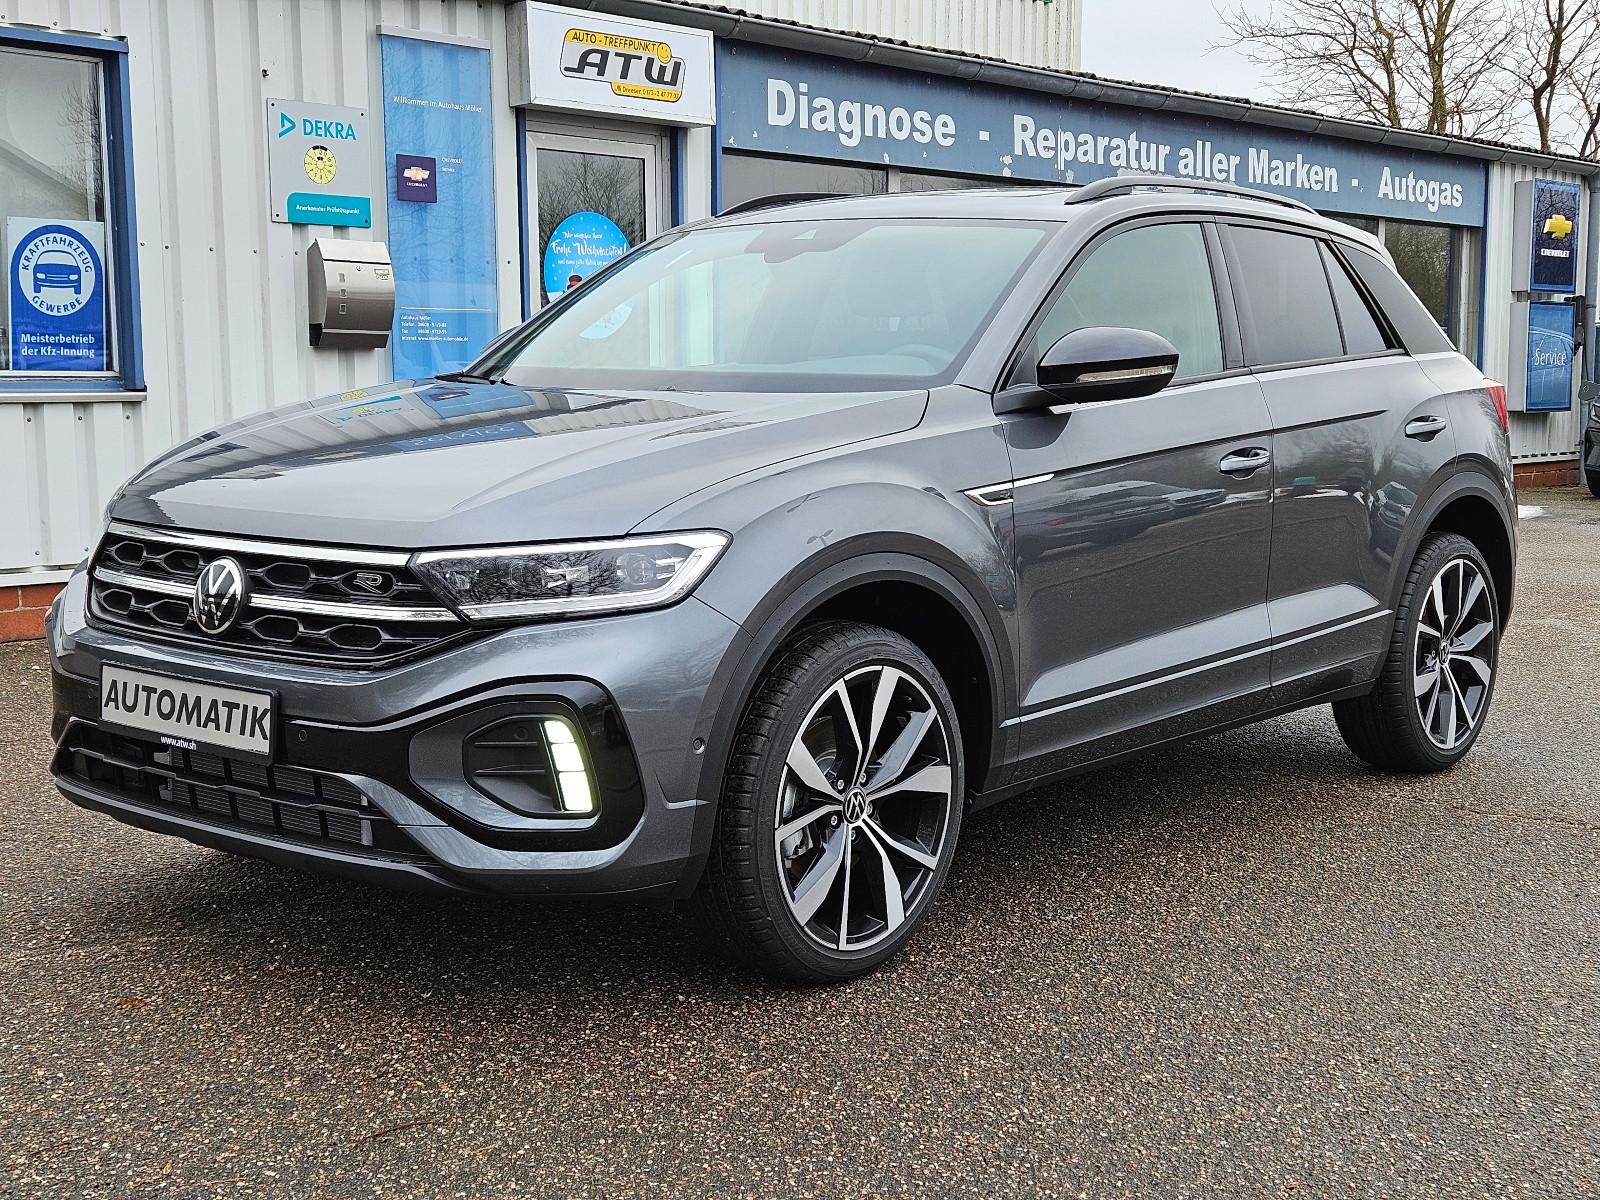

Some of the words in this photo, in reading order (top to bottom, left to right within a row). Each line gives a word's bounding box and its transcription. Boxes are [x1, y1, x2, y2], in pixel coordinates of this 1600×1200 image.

[572, 31, 597, 44] AUTO
[603, 36, 657, 53] TREFFPUNKT
[564, 48, 682, 86] ATW
[393, 95, 429, 106] Willkommen
[438, 101, 465, 111] Autohaus
[302, 118, 357, 140] DEKRA
[767, 78, 956, 147] Diagnose
[1013, 114, 1171, 172] Reparatur
[1178, 140, 1241, 182] aller
[1248, 147, 1339, 193] Marken
[1377, 166, 1463, 213] Autogas
[21, 236, 93, 273] KRAFTFAHRZEUG
[32, 295, 83, 314] GEWERBE
[21, 333, 95, 344] Meisterbetrieb
[21, 346, 38, 356] der
[41, 346, 95, 359] Kfz-Innung
[1534, 349, 1567, 367] Service
[103, 679, 271, 741] AUTOMATIK
[160, 735, 197, 751] www.atw.sh
